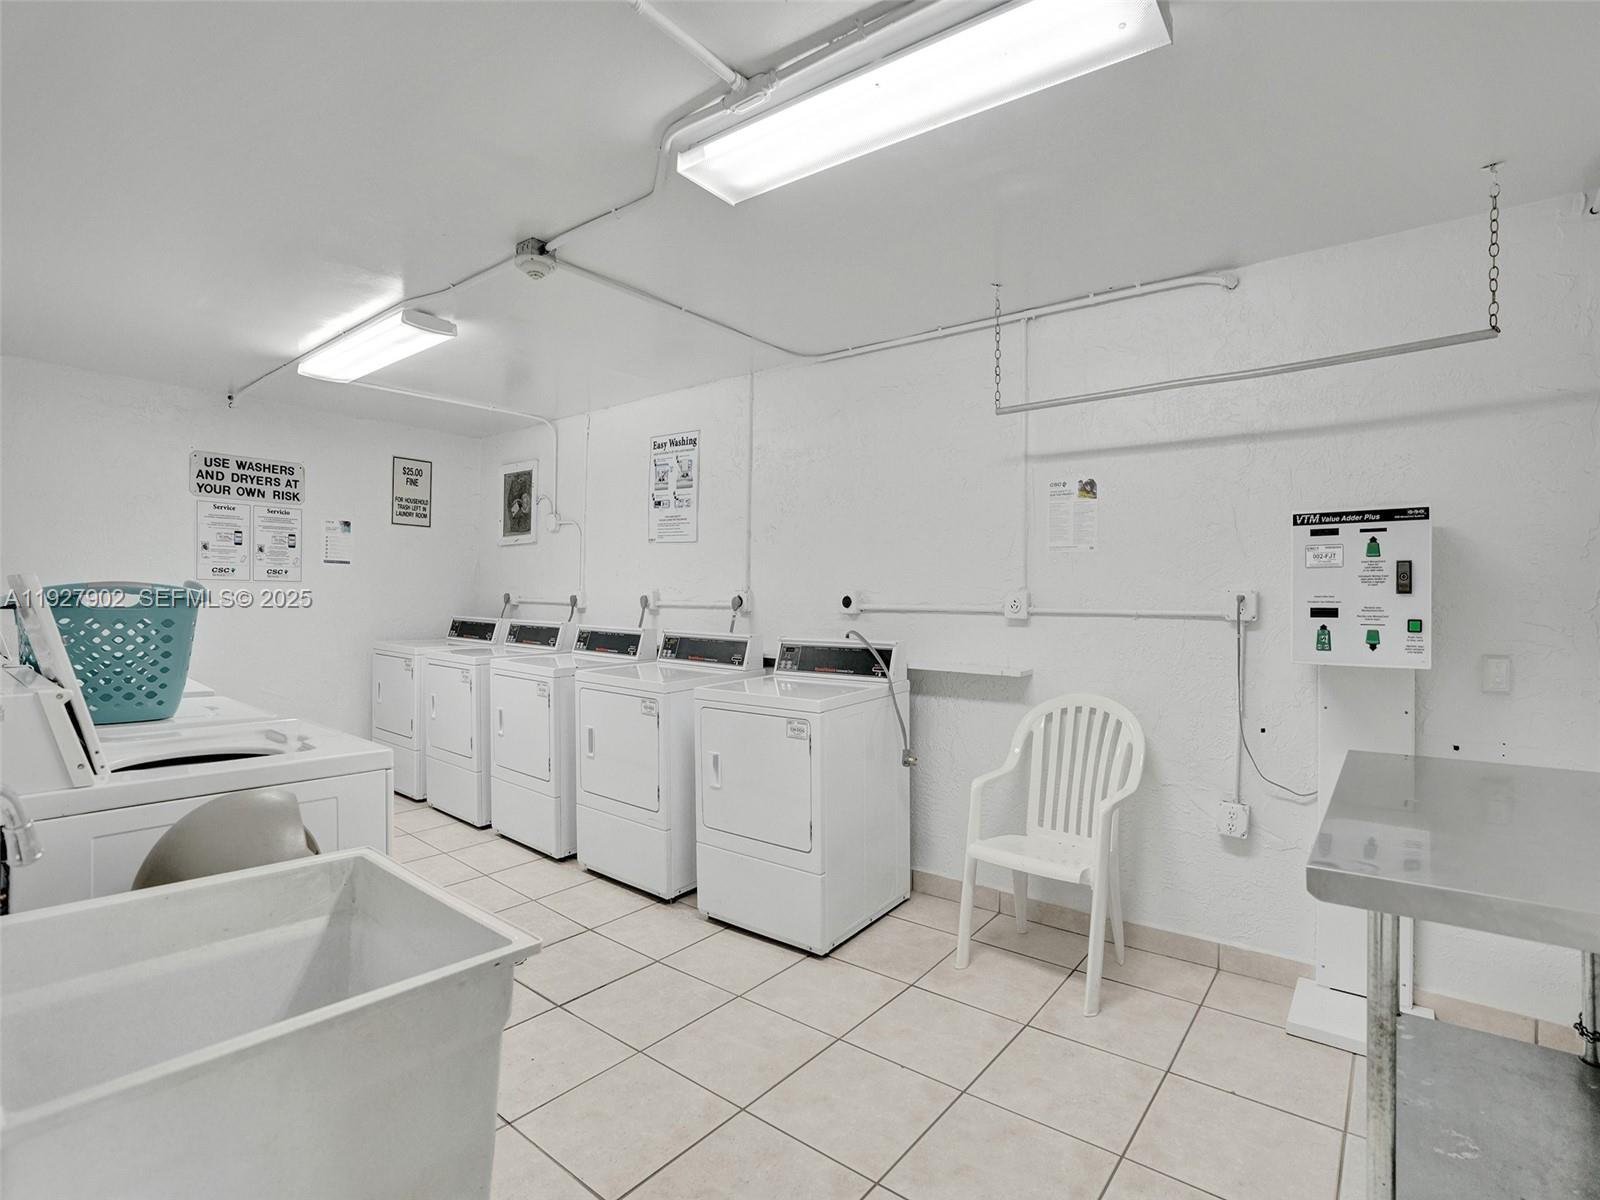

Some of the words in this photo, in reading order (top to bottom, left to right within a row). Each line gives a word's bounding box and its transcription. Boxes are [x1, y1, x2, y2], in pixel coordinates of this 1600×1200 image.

[652, 440, 668, 451] Easy
[668, 436, 698, 448] Washing
[204, 457, 230, 468] USE
[236, 460, 295, 476] WASHERS
[402, 466, 423, 477] $25.00
[196, 470, 225, 482] AND
[231, 472, 281, 487] DRYERS
[284, 479, 300, 490] AT
[406, 477, 419, 487] FINE
[196, 482, 231, 496] YOUR
[236, 486, 266, 498] OWN
[273, 490, 300, 502] RISK
[212, 504, 236, 512] Service
[266, 508, 290, 516] Servicio
[1296, 514, 1320, 525] VTM
